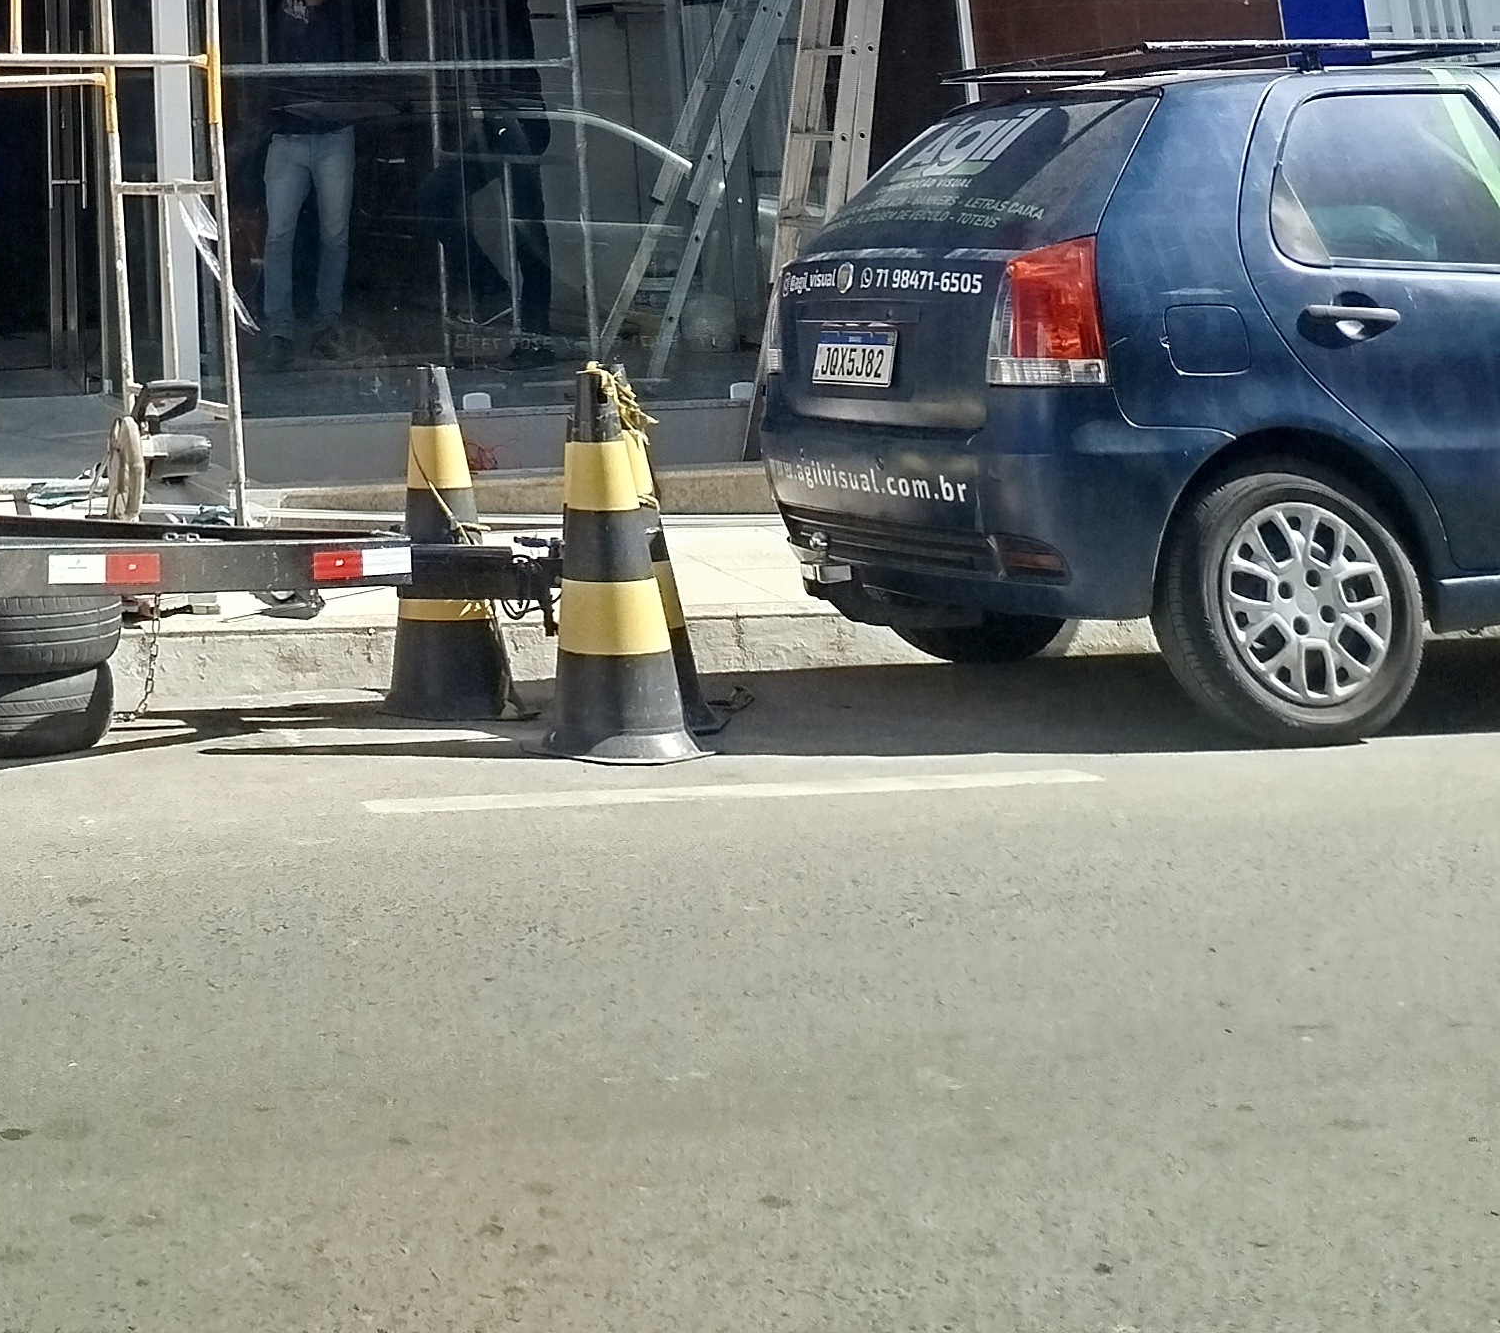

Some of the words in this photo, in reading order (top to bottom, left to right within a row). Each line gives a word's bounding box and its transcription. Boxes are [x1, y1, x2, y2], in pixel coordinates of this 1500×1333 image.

[956, 212, 1001, 229] TOTENS
[964, 197, 1011, 212] LETRAS
[1007, 201, 1046, 220] CAIXA
[876, 269, 889, 288] 71
[892, 269, 983, 294] 98471-6505
[820, 346, 885, 379] JQX5J82
